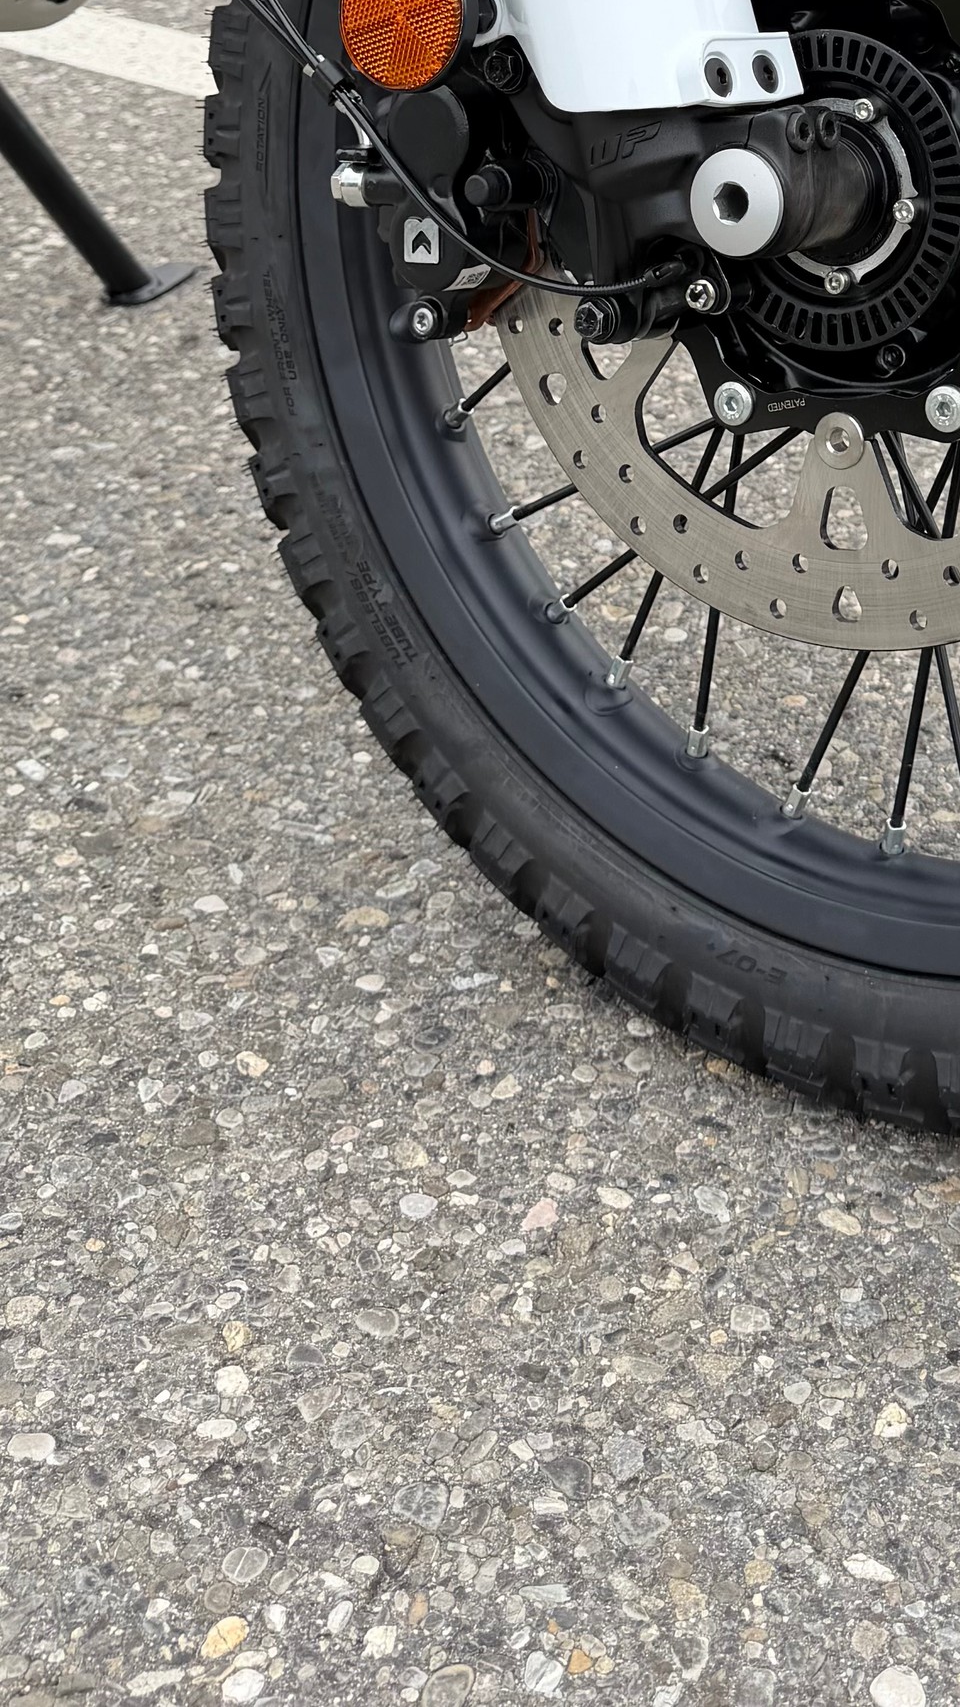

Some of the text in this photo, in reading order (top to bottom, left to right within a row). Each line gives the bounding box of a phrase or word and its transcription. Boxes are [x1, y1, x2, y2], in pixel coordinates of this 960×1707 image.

[254, 96, 266, 172] ROTATION
[590, 120, 663, 168] WP
[261, 269, 297, 415] FOR FRONT WHEEL
[274, 304, 297, 380] USE ONLY
[767, 397, 806, 413] PATENTED
[343, 570, 407, 670] TUBELESS/
[354, 558, 419, 663] TUBE TYPE
